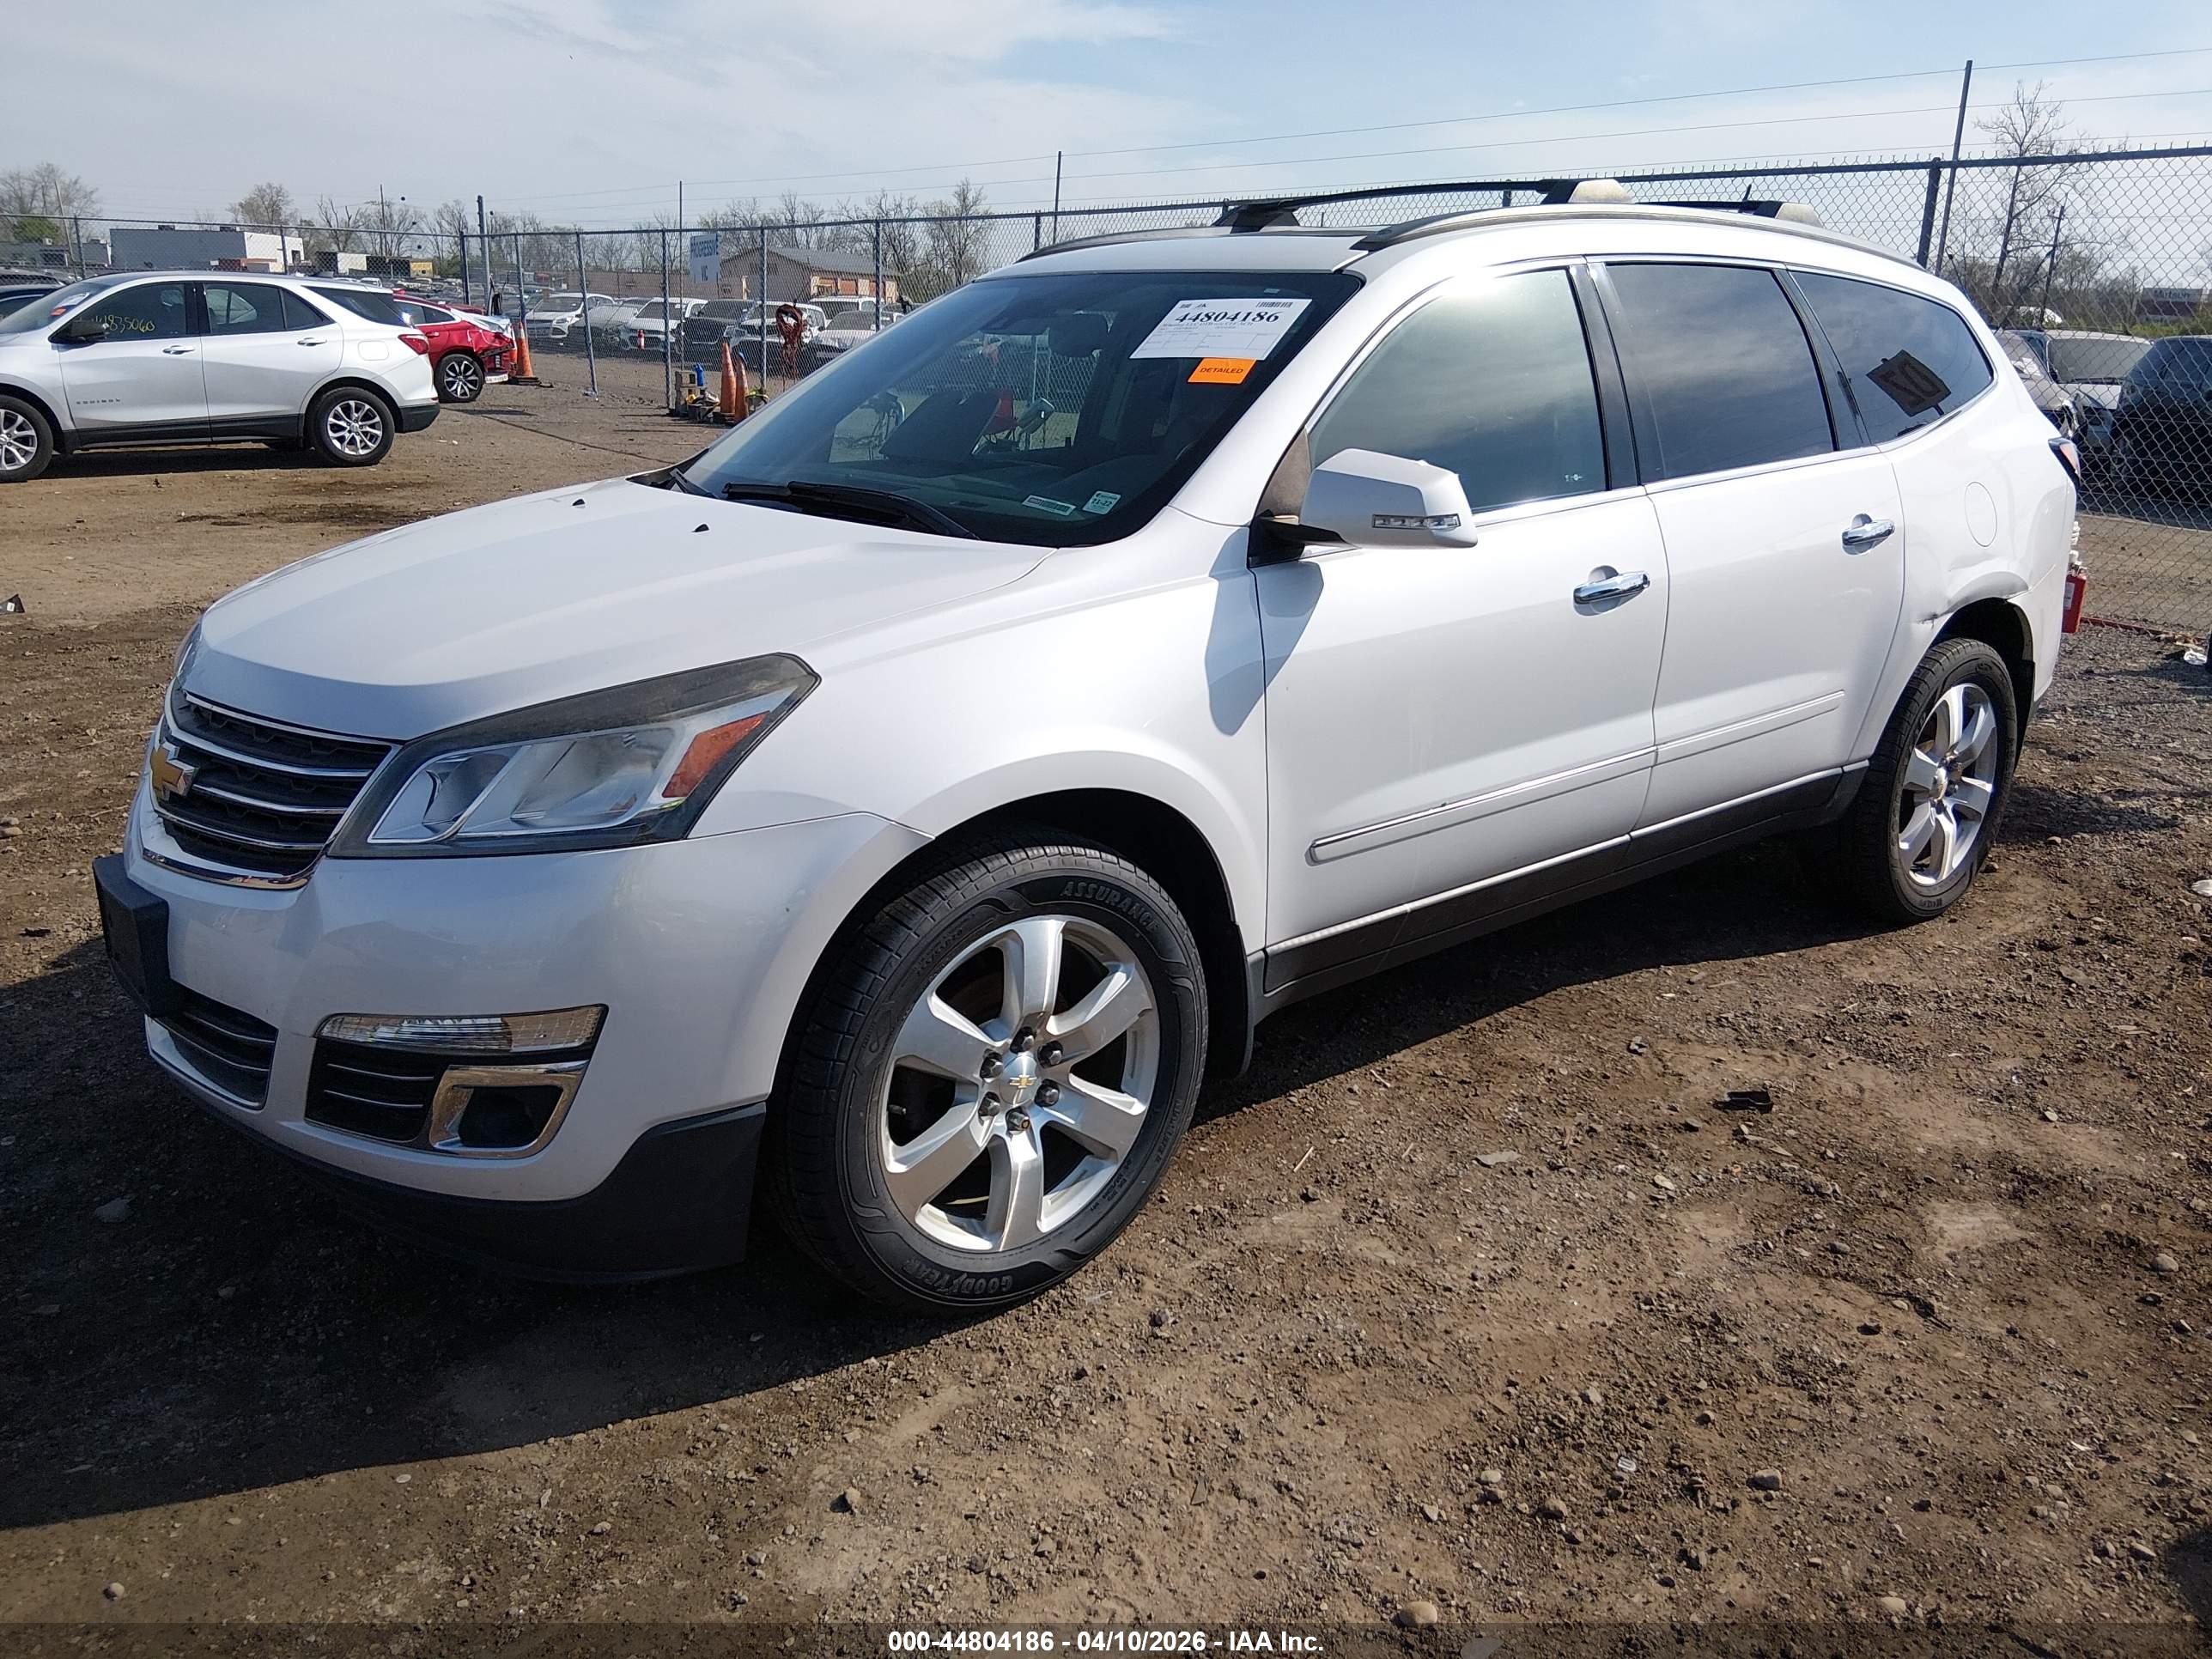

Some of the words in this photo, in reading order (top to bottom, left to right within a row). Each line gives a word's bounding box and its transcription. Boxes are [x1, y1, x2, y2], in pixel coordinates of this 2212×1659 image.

[1175, 311, 1284, 323] 44804186
[1060, 881, 1159, 932] ASSURANCE
[902, 1256, 1013, 1295] GOODYEAR
